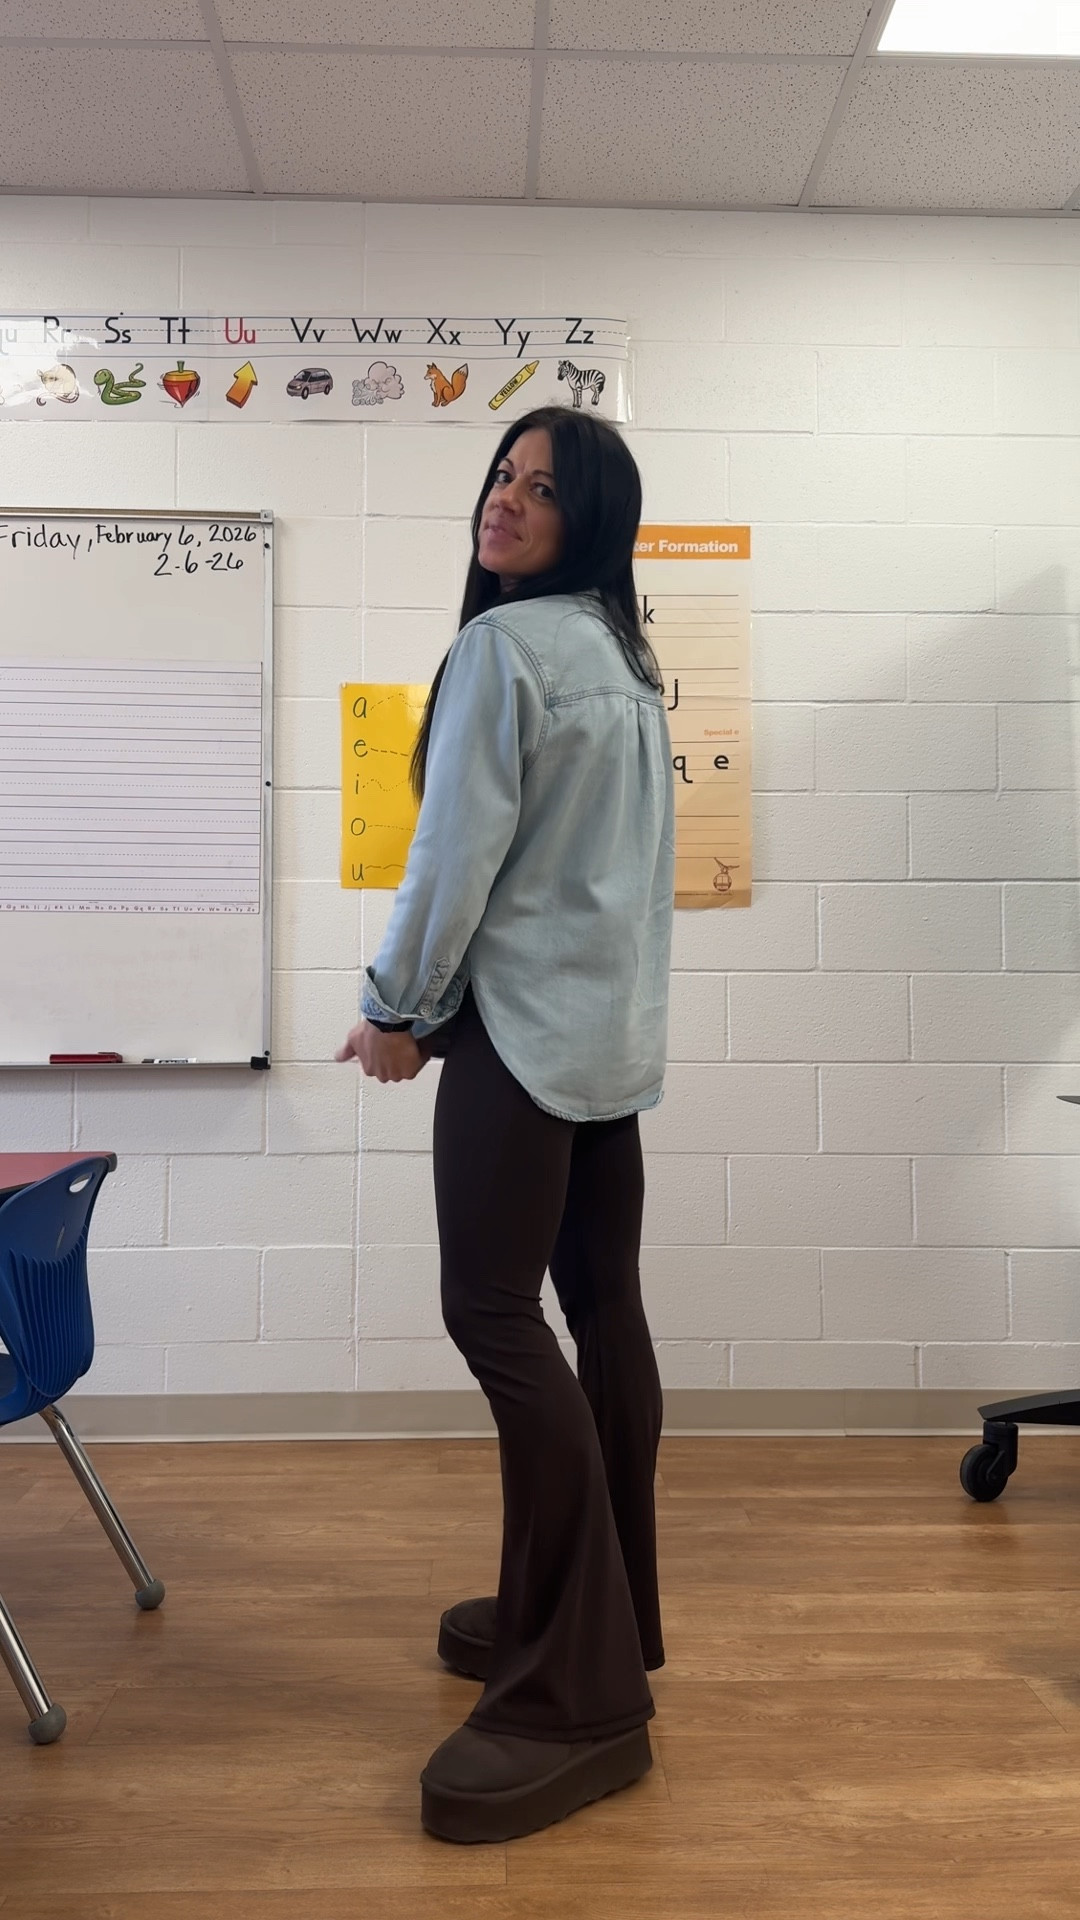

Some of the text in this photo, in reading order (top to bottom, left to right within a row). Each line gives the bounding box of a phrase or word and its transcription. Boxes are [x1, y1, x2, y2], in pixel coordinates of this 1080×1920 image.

[43, 316, 72, 343] Rr
[105, 316, 132, 343] Ss
[160, 317, 190, 343] Tt
[225, 317, 256, 343] Uu
[291, 317, 325, 343] Vv
[352, 317, 402, 343] Ww
[427, 318, 461, 345] Xx
[494, 318, 531, 358] Yy
[565, 318, 594, 344] Zz
[500, 378, 518, 397] YELLOW
[96, 524, 172, 552] February
[208, 524, 257, 542] 2026
[658, 540, 738, 553] Formation
[643, 594, 655, 624] k
[668, 678, 678, 711] j
[353, 697, 367, 719] a
[704, 728, 733, 737] Special
[354, 739, 368, 758] e
[673, 755, 729, 784] q e
[355, 773, 360, 795] i
[350, 817, 366, 836] o
[352, 863, 365, 881] u
